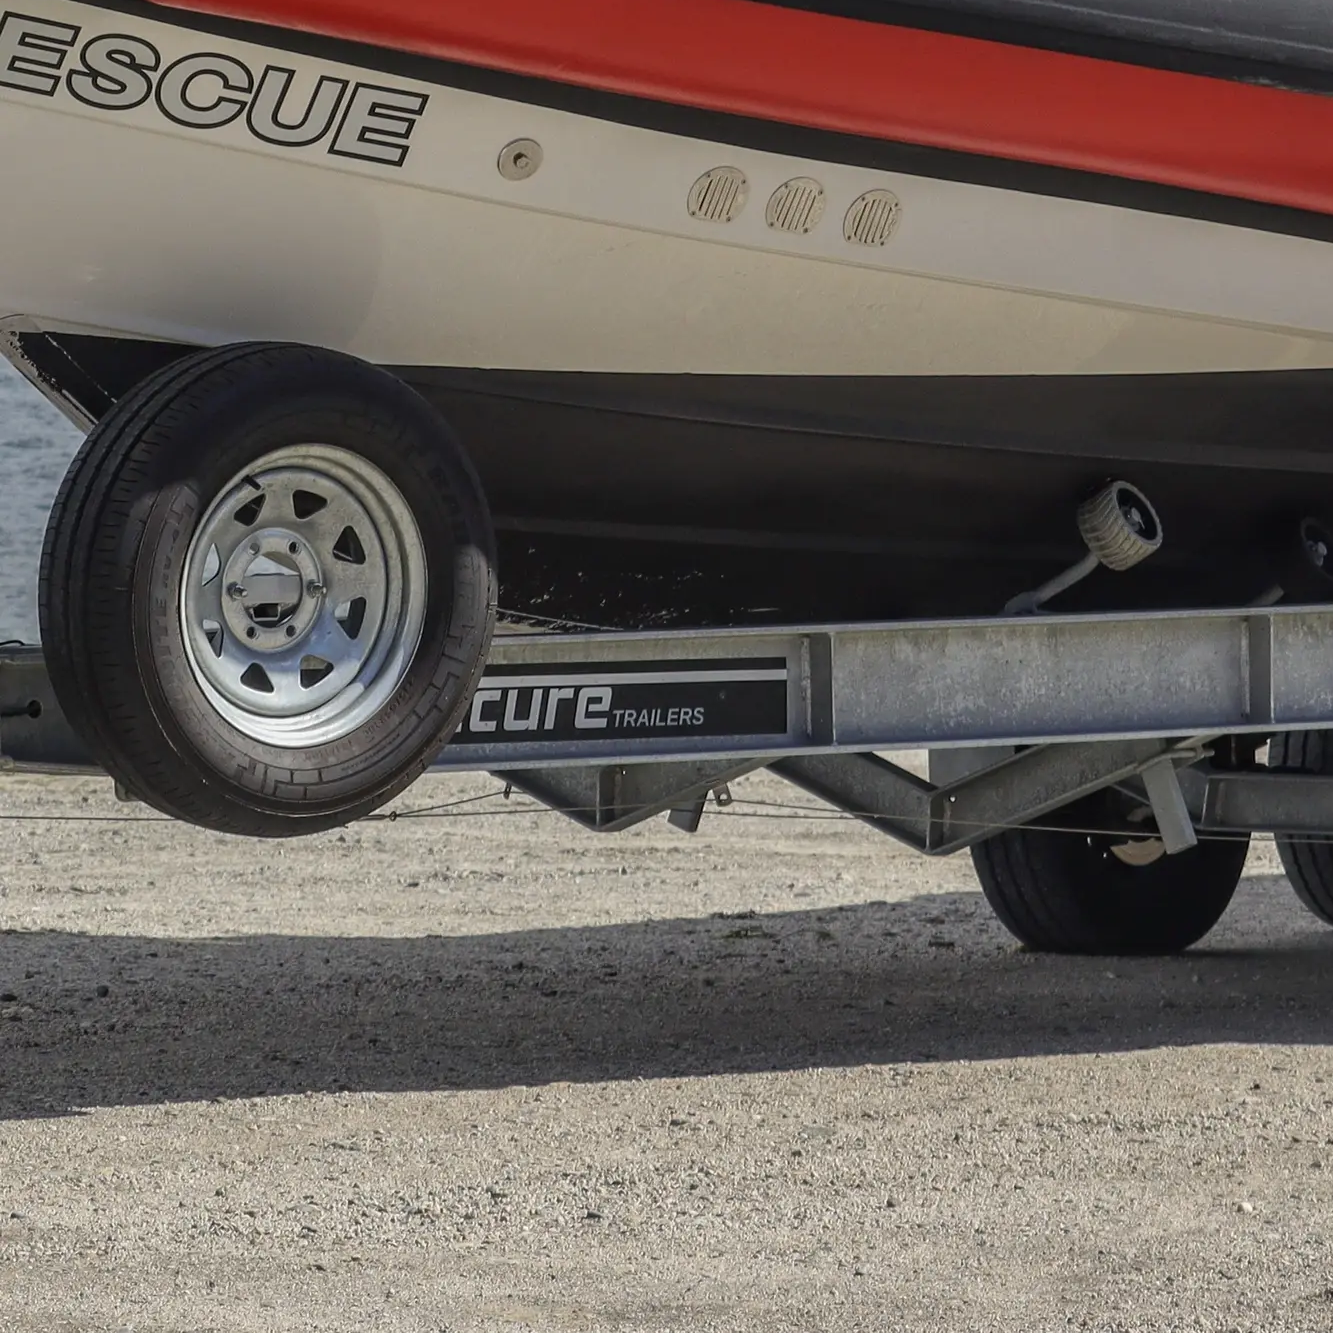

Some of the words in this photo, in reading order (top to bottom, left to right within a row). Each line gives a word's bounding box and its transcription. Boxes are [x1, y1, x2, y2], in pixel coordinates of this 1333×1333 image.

[0, 10, 430, 167] ESCUE
[455, 686, 613, 733] cure
[612, 707, 704, 728] TRAILERS
